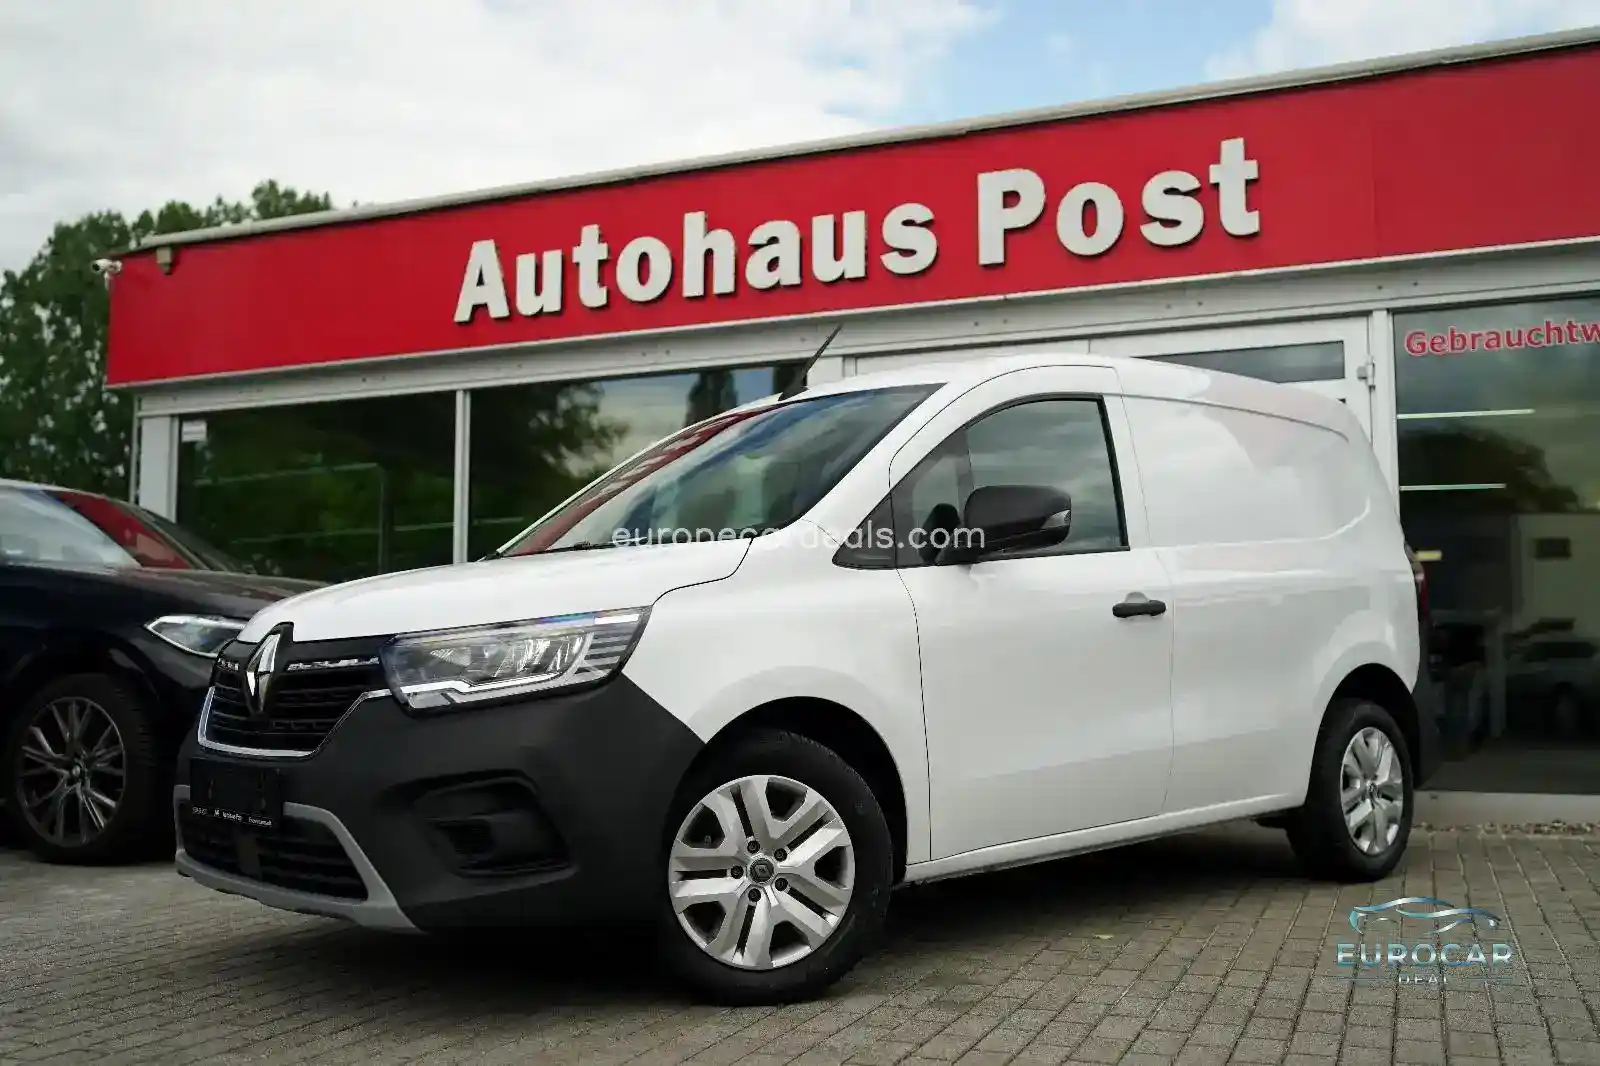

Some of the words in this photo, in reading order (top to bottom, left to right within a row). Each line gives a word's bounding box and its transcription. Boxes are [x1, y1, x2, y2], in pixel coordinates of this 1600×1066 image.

[454, 201, 939, 324] Autohaus
[976, 137, 1261, 268] Post
[1404, 318, 1600, 357] Gebrauchtw
